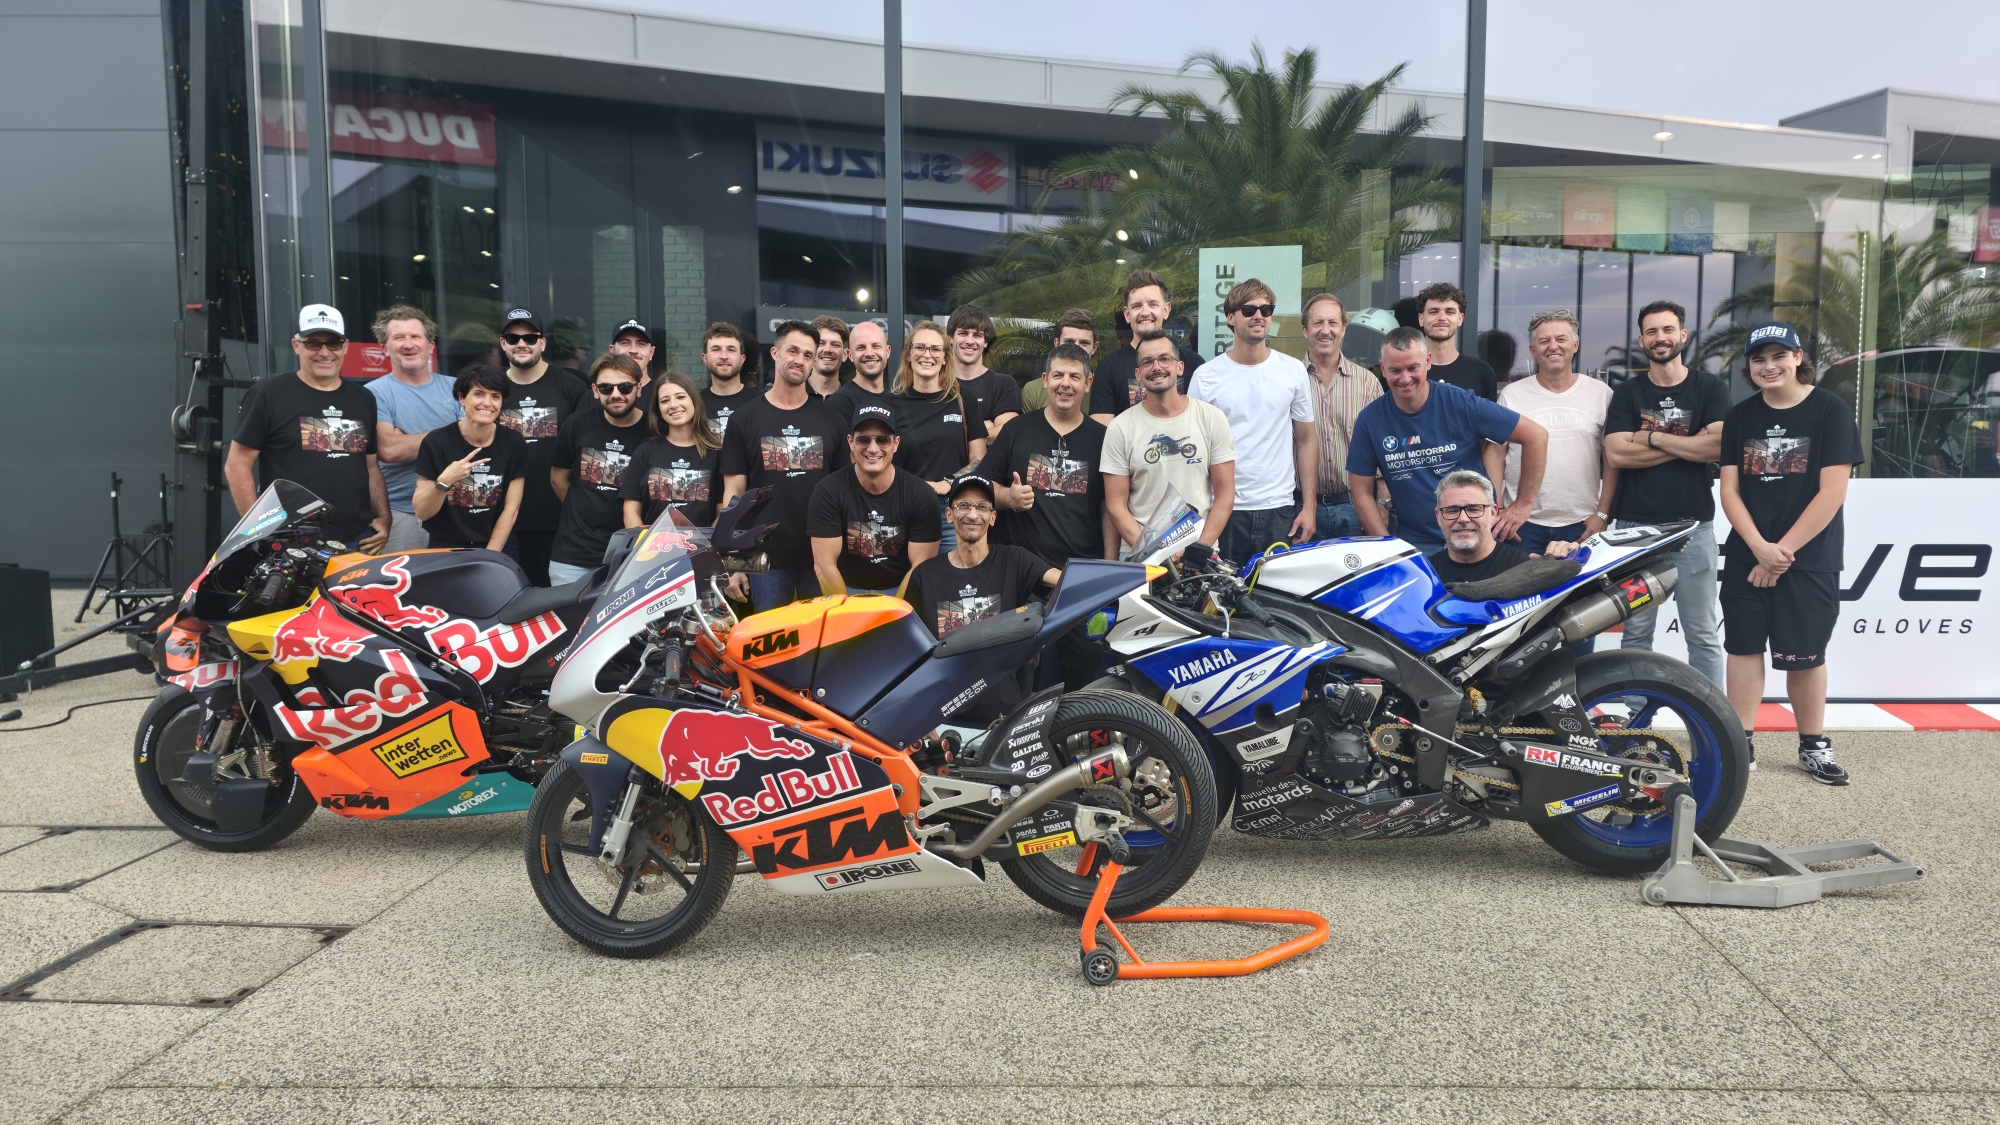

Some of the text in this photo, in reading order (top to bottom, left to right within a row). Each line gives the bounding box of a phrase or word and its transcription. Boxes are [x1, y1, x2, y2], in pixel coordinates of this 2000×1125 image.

[859, 406, 891, 417] DUCATI
[1550, 412, 1586, 428] Dutch
[1385, 443, 1457, 461] BMW MOTORRAD
[1387, 455, 1443, 469] MOTORSPORT
[255, 513, 283, 531] MOTOREX
[1161, 519, 1194, 546] YAMAHA
[338, 569, 369, 583] KTM
[604, 587, 636, 616] IPONE
[1502, 594, 1543, 619] YAMAHA
[1853, 619, 1974, 634] GLOVES
[426, 611, 567, 683] Bull
[742, 629, 799, 661] KTM
[1772, 651, 1817, 662] スポーツ
[1168, 648, 1238, 684] YAMAHA
[274, 648, 428, 750] Red
[941, 688, 972, 712] SPEED
[379, 736, 422, 763] inter
[1012, 742, 1043, 758] GALFER
[1242, 736, 1281, 754] YAMALUBE
[1569, 734, 1599, 748] NGK
[395, 738, 453, 771] wetten
[438, 748, 457, 762] .news
[581, 754, 607, 763] PIRELLI
[1526, 747, 1558, 763] RK
[1011, 760, 1026, 772] 2D
[1560, 762, 1604, 776] EQUIPEMENT
[1561, 754, 1622, 774] FRANCE
[702, 752, 862, 825] Red Bull
[1240, 784, 1277, 801] mutuelle
[1242, 784, 1313, 811] motards
[1574, 788, 1619, 806] MICHELIN
[321, 791, 390, 811] KTM
[447, 787, 499, 816] MOTOREX
[1041, 813, 1064, 822] OAKLEY
[1234, 814, 1283, 832] GEMA
[751, 805, 909, 877] KTM
[1023, 835, 1070, 854] PIRELLI
[840, 859, 917, 883] IPONE
